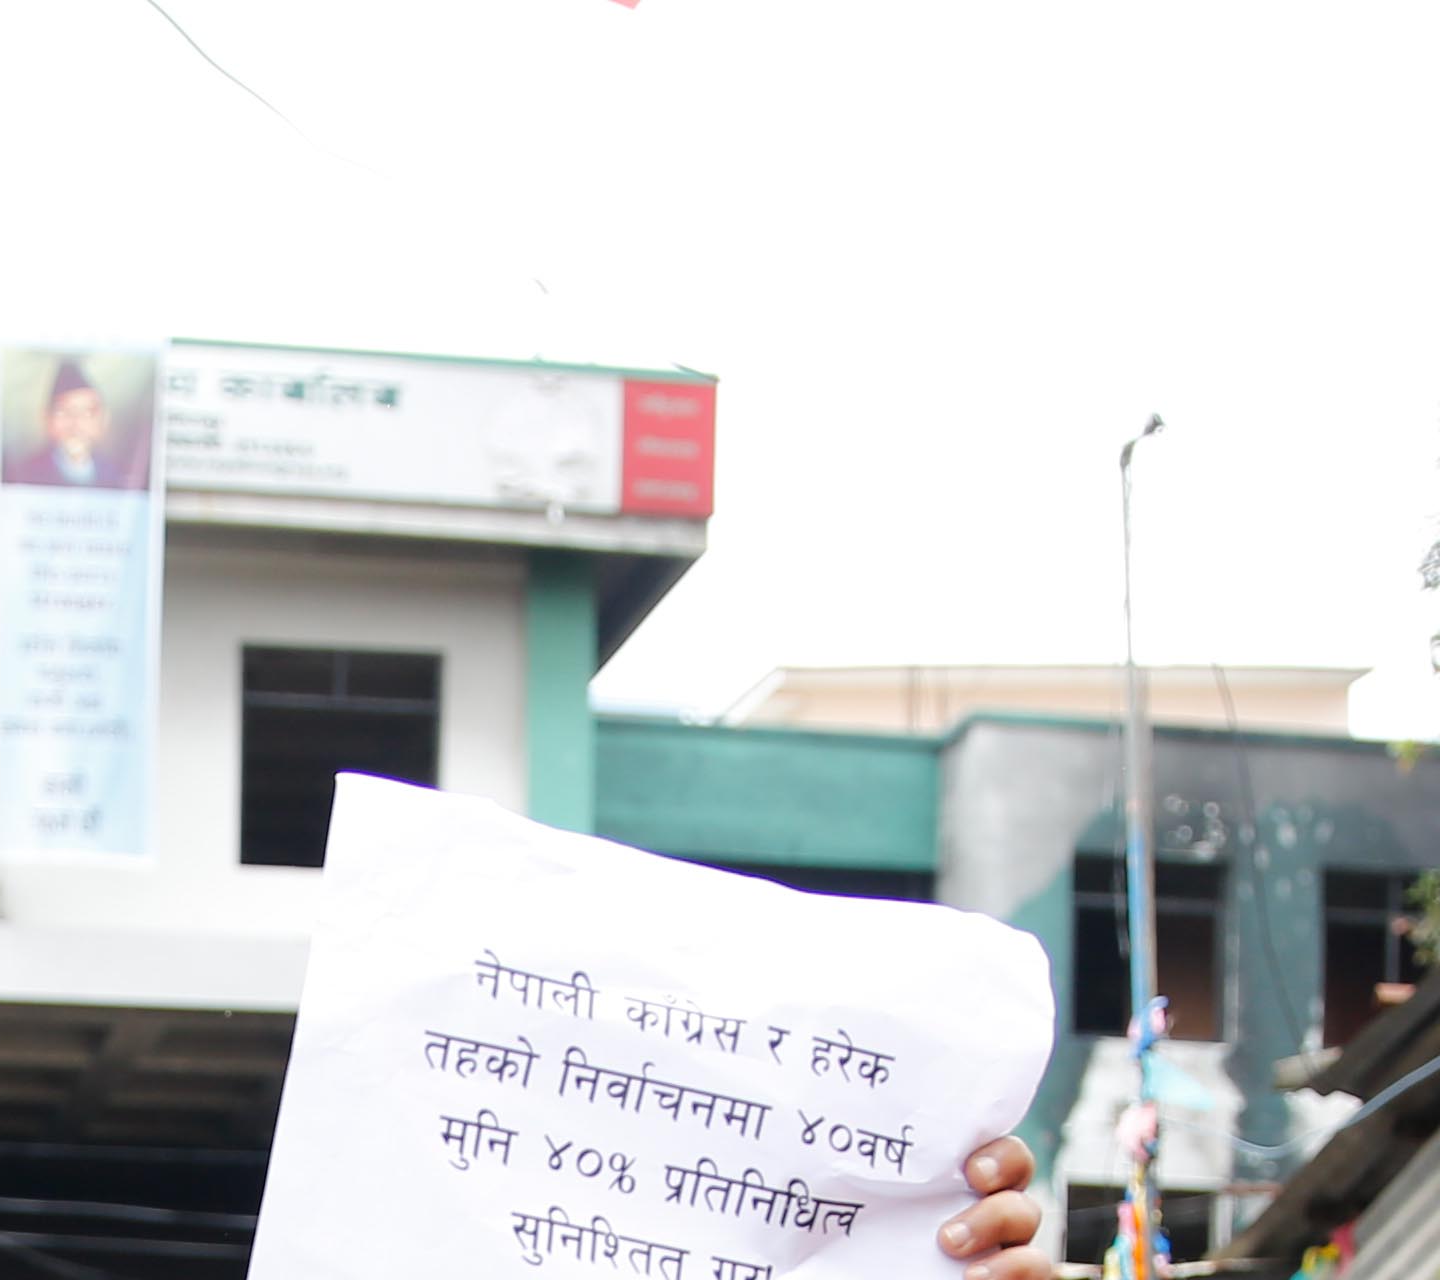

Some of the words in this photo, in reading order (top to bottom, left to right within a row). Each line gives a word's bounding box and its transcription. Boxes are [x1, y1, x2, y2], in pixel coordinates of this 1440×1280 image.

[474, 949, 600, 1020] नेपाली
[624, 994, 748, 1053] काँग्रेस
[768, 1026, 791, 1064] र
[811, 1029, 897, 1089] हरेक
[422, 1029, 540, 1091] तहको
[560, 1047, 774, 1142] निर्वाचनमा
[796, 1108, 917, 1177] ४०वर्ष
[439, 1108, 521, 1171] मुनि
[544, 1134, 639, 1195] ४०%
[663, 1158, 866, 1240] प्रतिनिधित्व
